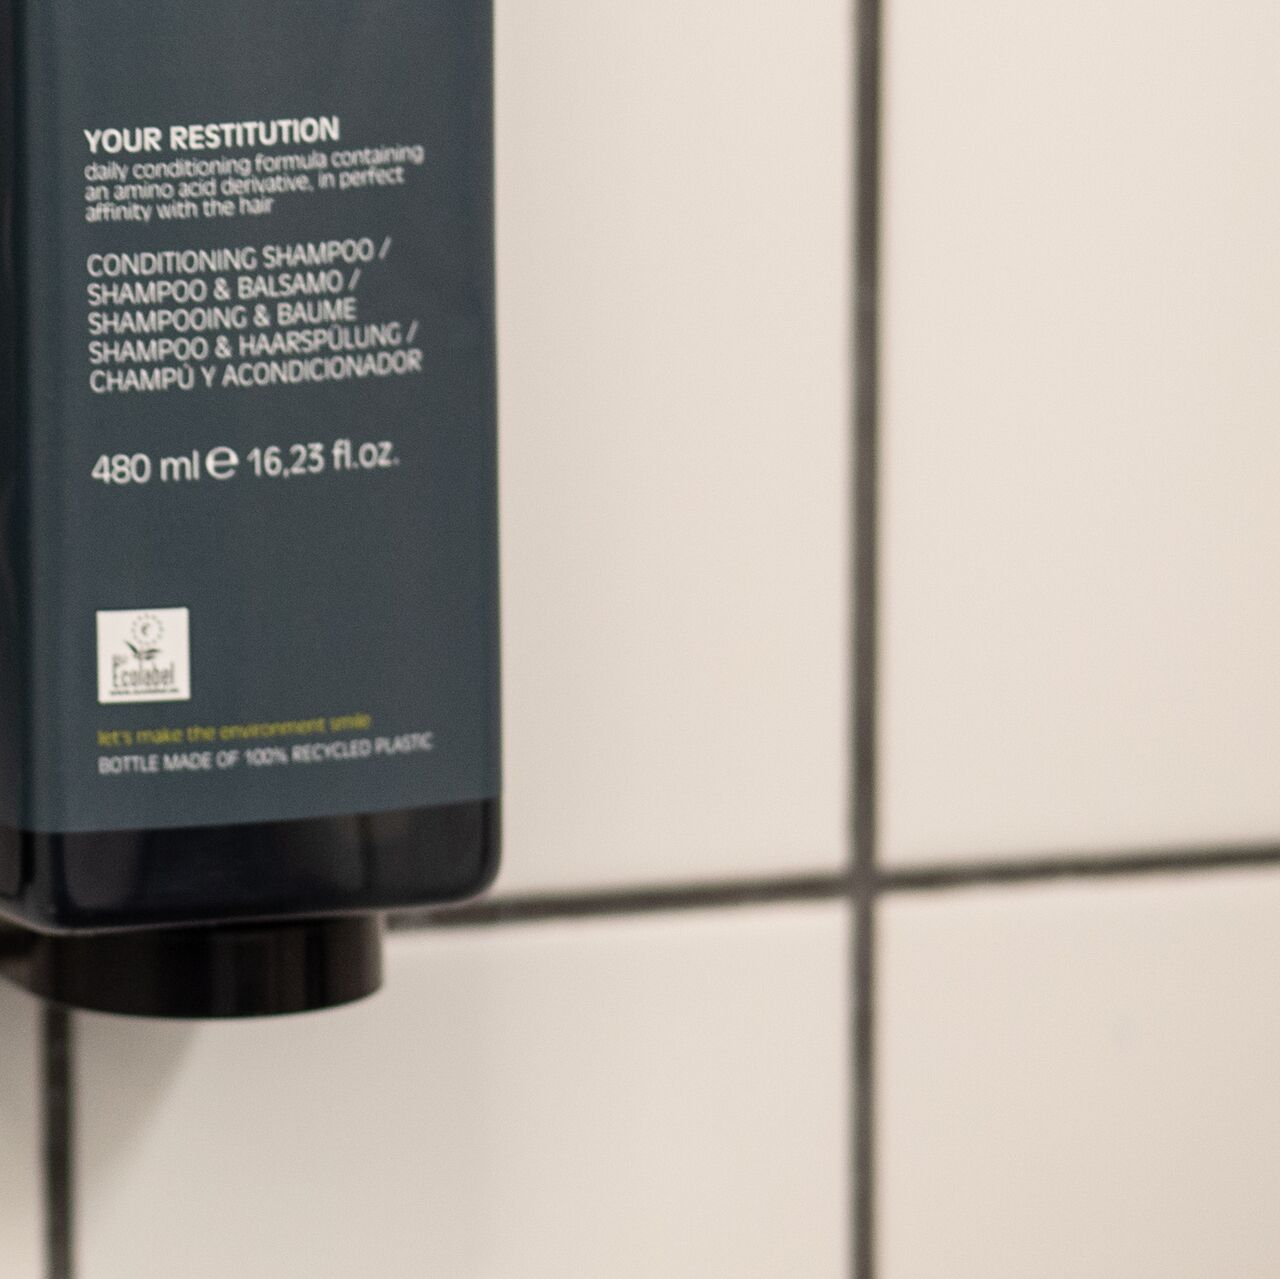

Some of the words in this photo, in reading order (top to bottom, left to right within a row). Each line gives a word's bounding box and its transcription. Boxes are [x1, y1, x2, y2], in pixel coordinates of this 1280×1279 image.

[83, 127, 161, 154] YOUR
[169, 116, 340, 150] RESTITUTION
[85, 161, 128, 182] daily
[133, 156, 251, 179] conditioning
[255, 152, 327, 174] formula
[330, 144, 424, 168] containing
[85, 183, 109, 201] an
[113, 181, 173, 199] amino
[178, 177, 217, 198] acid
[318, 171, 335, 189] in
[339, 167, 404, 190] perfect
[85, 200, 152, 223] affinity
[157, 199, 198, 219] with
[203, 197, 234, 217] the
[239, 194, 274, 214] hair
[87, 246, 258, 278] CONDITIONING
[262, 238, 374, 268] SHAMPOO
[87, 279, 206, 306] SHAMPOO
[214, 278, 231, 300] &
[238, 271, 343, 298] BALSAMO
[87, 306, 248, 335] SHAMPOOING
[253, 306, 270, 327] &
[276, 298, 357, 325] BAUME
[88, 336, 208, 364] SHAMPOO
[215, 335, 232, 359] &
[239, 322, 401, 356] HAARSPÜLUNG
[200, 364, 216, 386] Y
[222, 350, 423, 387] ACONDICIONADOR
[91, 453, 150, 484] 480
[332, 440, 399, 471] fl.oz.
[219, 719, 325, 741] environment
[329, 713, 371, 732] smile
